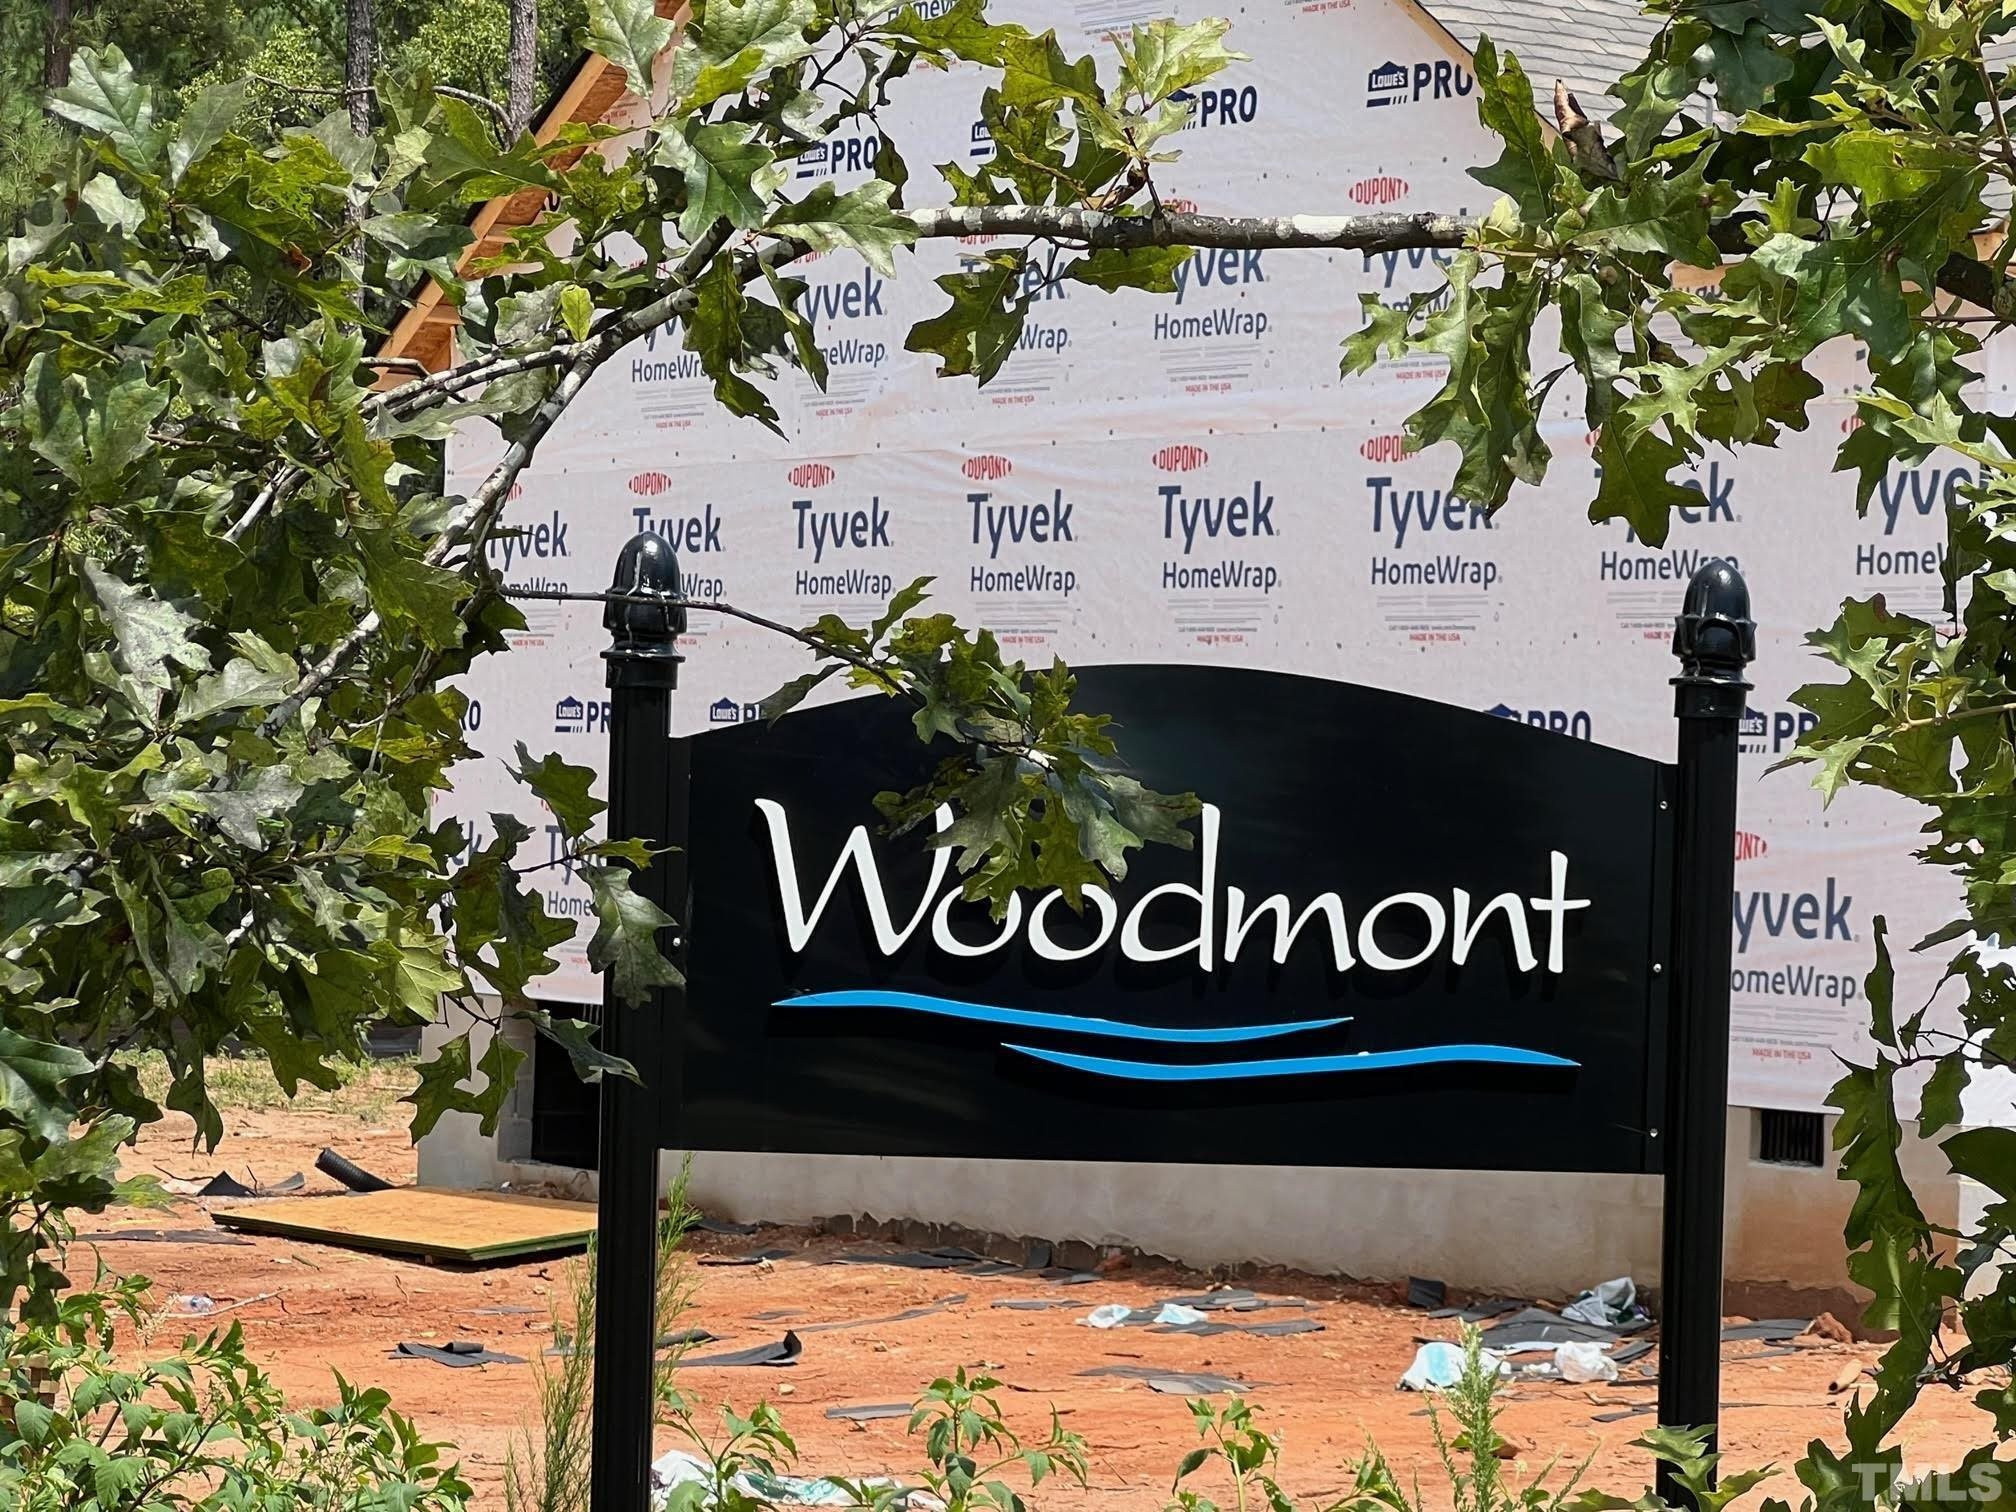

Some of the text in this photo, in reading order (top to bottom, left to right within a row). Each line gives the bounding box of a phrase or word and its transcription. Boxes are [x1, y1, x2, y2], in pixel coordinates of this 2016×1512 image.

[1371, 60, 1473, 102] LOWE'S PRO
[1200, 85, 1257, 127] PRO
[831, 136, 878, 174] PRO
[1356, 177, 1402, 204] DUPONT
[1173, 248, 1265, 305] yvek
[790, 266, 883, 328] yvek
[1013, 323, 1068, 354] Wrap
[1154, 308, 1268, 340] HomeWrap
[632, 355, 706, 382] HomeWr
[1159, 445, 1203, 472] DUPONT
[1367, 435, 1413, 463] DUPO
[633, 472, 667, 495] DUPONT
[793, 463, 830, 488] DUPONT
[967, 455, 1008, 480] DUPONT
[792, 496, 890, 563] Tyvek
[967, 489, 1074, 559] Tyvek
[1158, 481, 1275, 555] Tyvek
[1371, 556, 1497, 591] HomeWrap
[1601, 549, 1738, 580] HomeW
[1856, 543, 1944, 576] Home
[681, 573, 723, 602] Wrap
[796, 569, 892, 600] HomeWrap
[970, 565, 1076, 597] HomeWrap
[1162, 560, 1277, 594] HomeWrap
[558, 701, 611, 733] LOWE'S PR
[755, 798, 1592, 974] Woodmont
[548, 890, 592, 917] Home
[1734, 877, 1853, 954] yvek
[1731, 965, 1857, 1007] omeWrap
